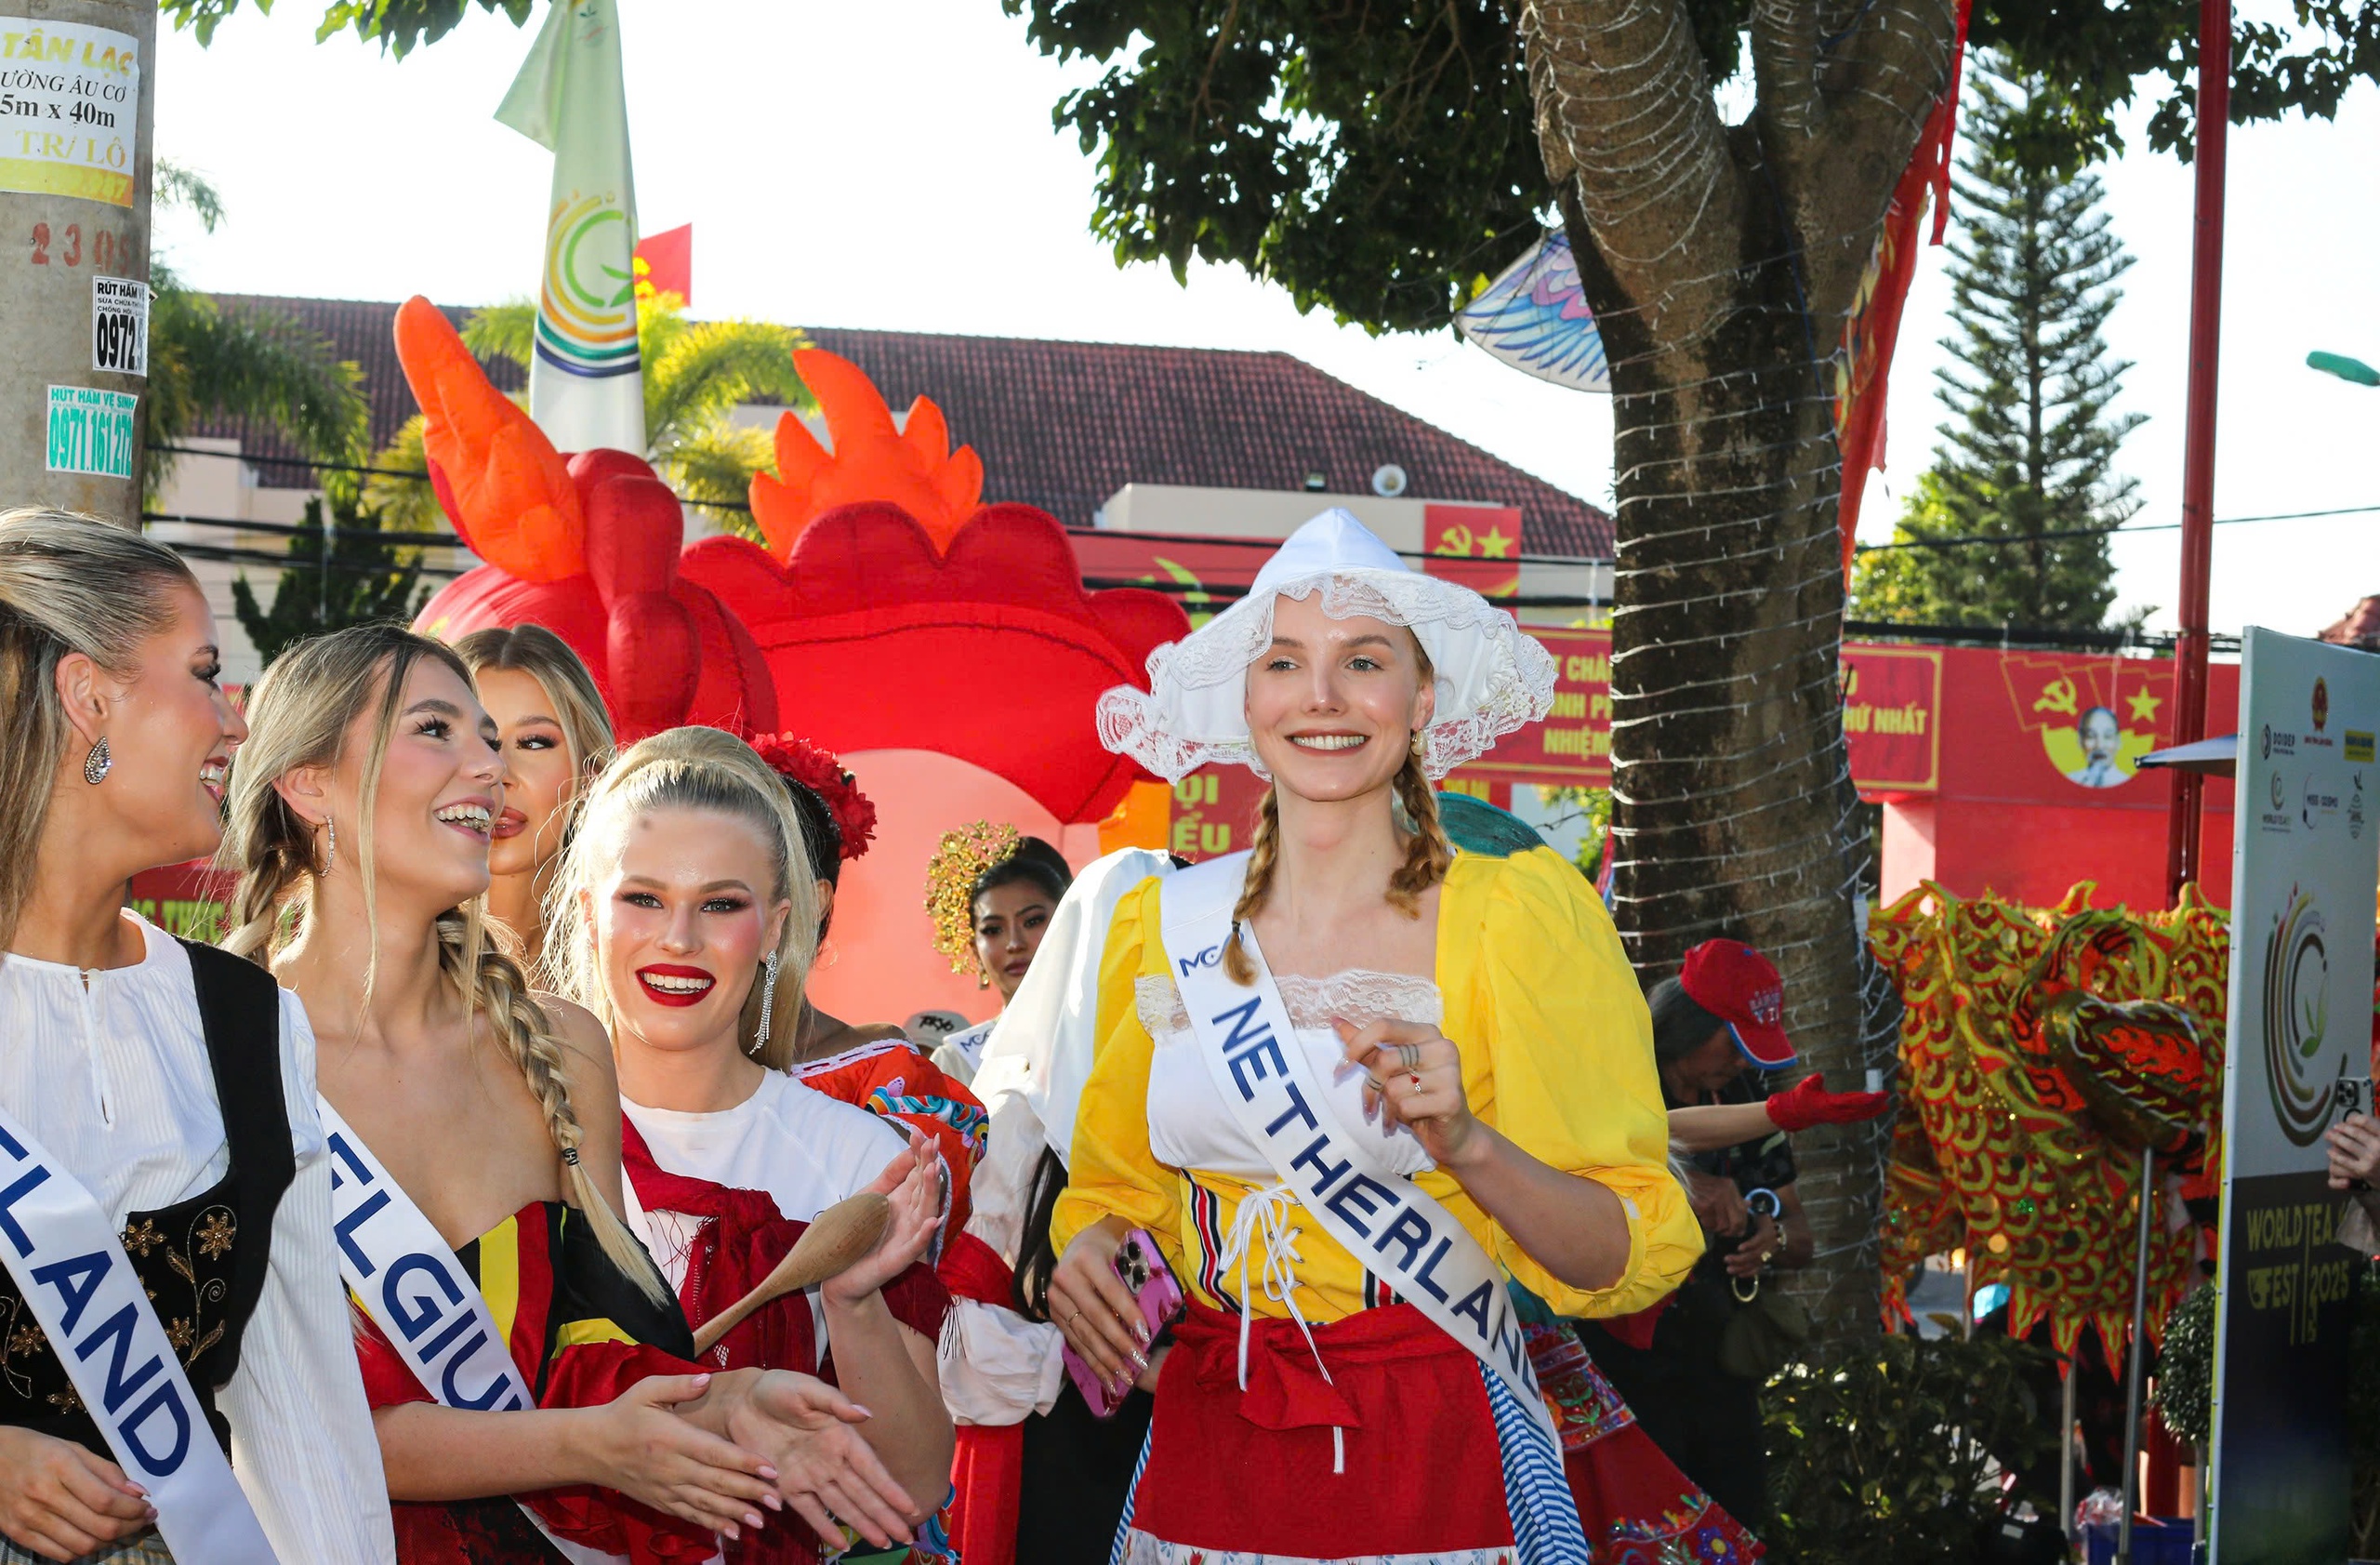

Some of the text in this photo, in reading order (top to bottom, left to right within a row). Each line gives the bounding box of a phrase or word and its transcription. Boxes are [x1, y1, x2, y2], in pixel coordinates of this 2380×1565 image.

[3, 27, 134, 78] TÂN LẠC
[69, 74, 99, 97] ÂU
[47, 103, 61, 119] x
[70, 100, 115, 128] 40m
[86, 136, 126, 168] LÔ
[98, 281, 117, 295] RÚT
[117, 394, 136, 410] SINH
[1873, 700, 1927, 735] NHẤT
[2246, 1205, 2303, 1253] WORLD
[2308, 1260, 2350, 1305] 2025
[0, 1124, 192, 1478] LAND
